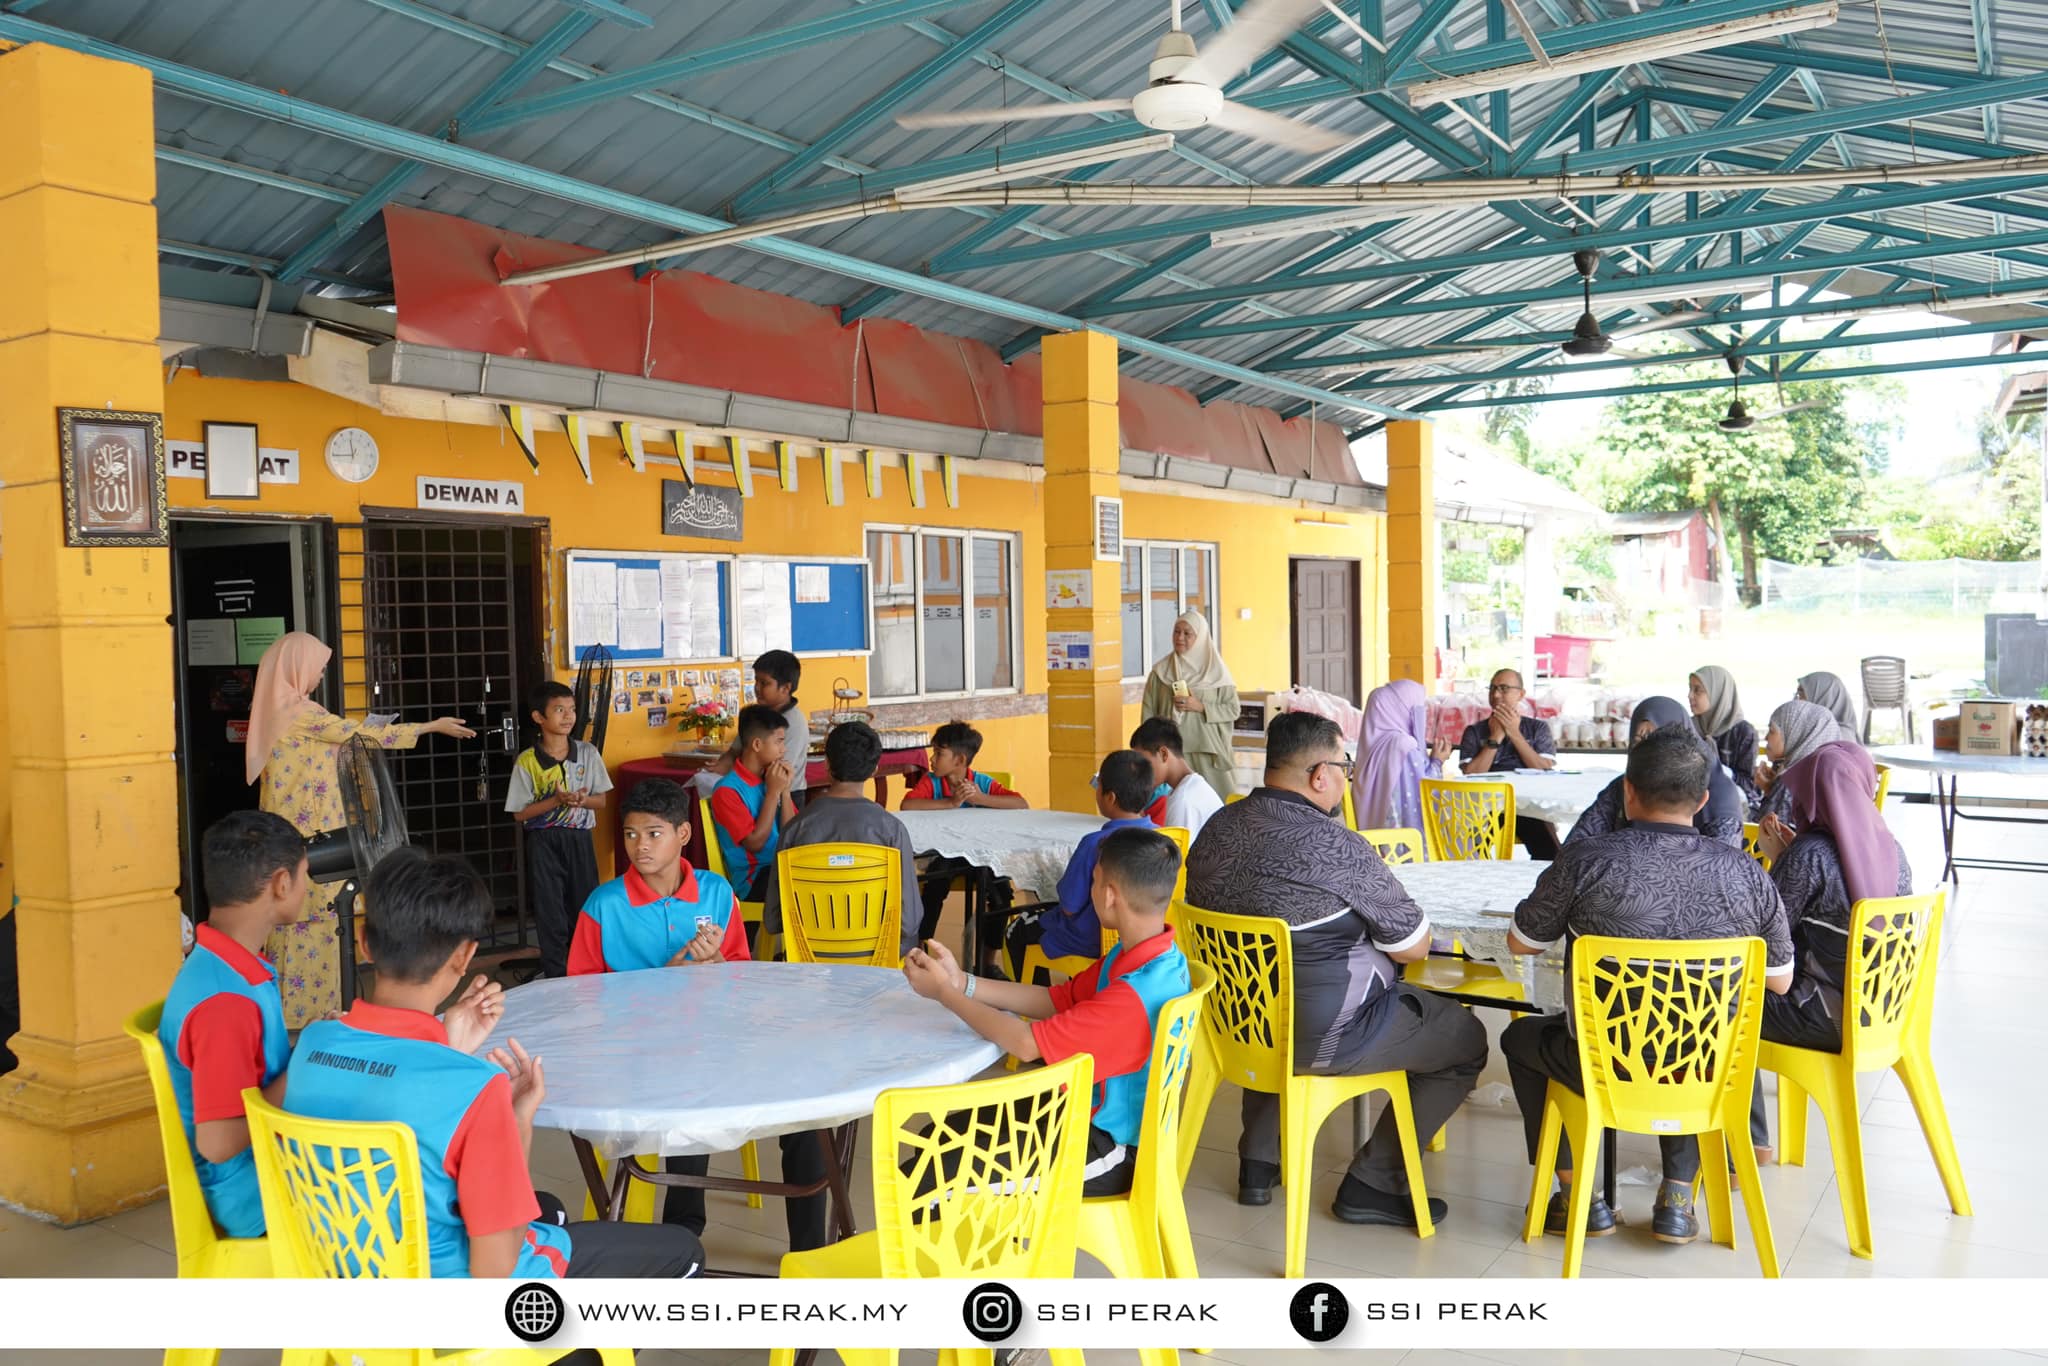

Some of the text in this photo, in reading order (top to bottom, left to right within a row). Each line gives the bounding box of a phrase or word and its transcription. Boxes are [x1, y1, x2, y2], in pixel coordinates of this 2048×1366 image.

[171, 449, 290, 476] PEAT
[424, 483, 519, 506] DEWAN A
[307, 1049, 398, 1079] AMINUDDIN BAKI
